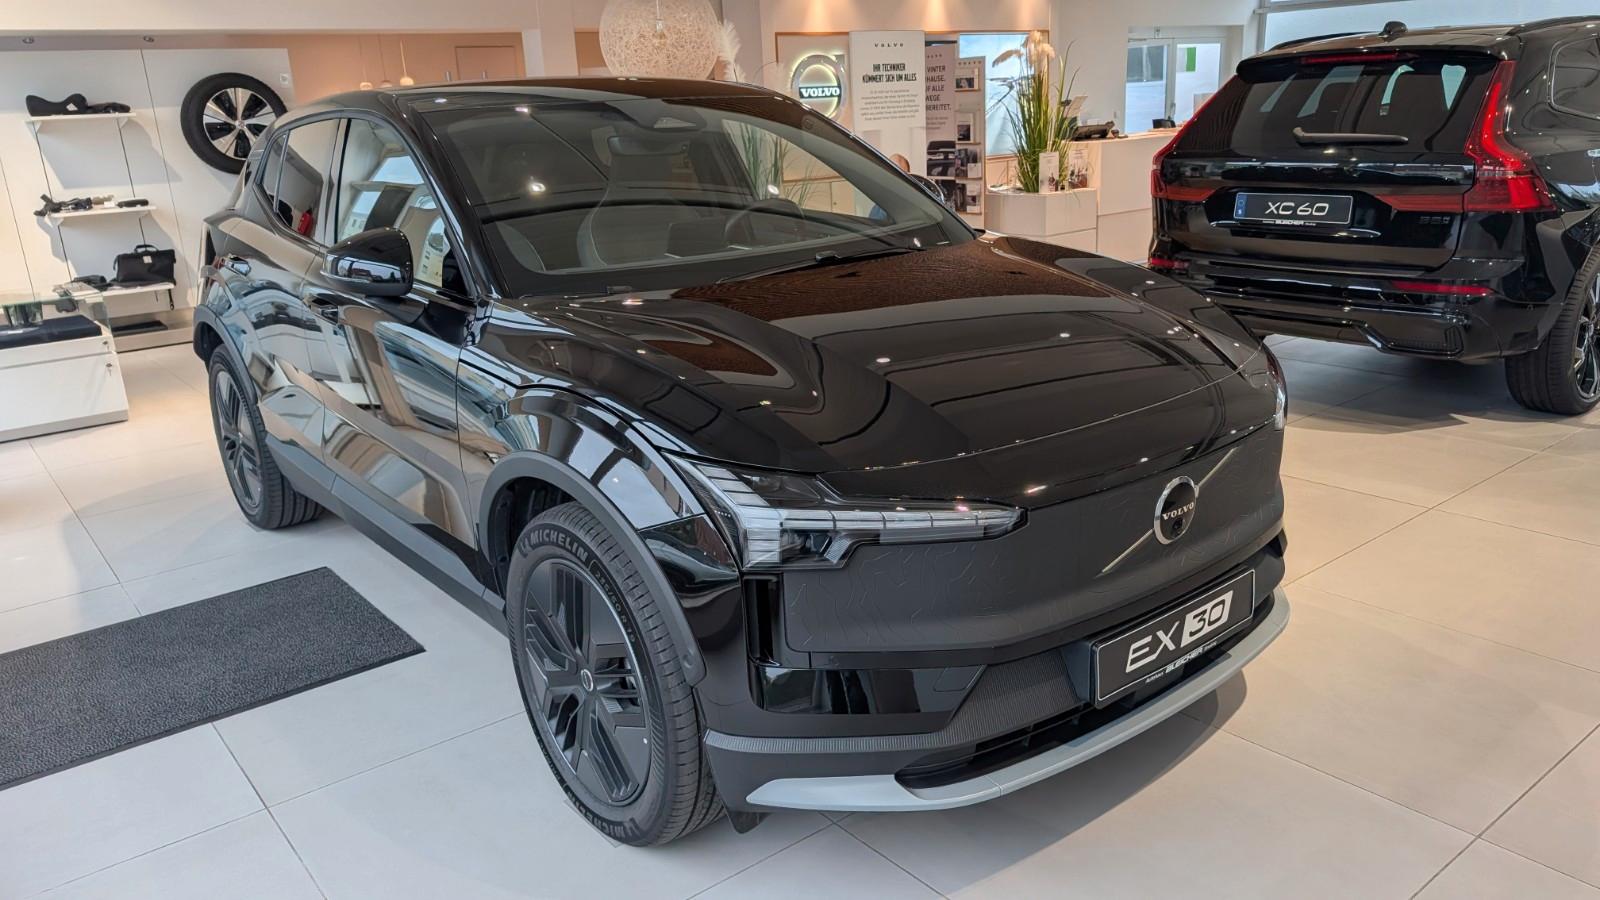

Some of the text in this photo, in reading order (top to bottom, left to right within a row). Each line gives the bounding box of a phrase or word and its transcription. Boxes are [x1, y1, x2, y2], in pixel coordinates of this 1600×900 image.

[872, 63, 906, 72] IHR TECHNIKER
[885, 73, 895, 82] SICH
[895, 73, 903, 82] UM
[904, 72, 917, 82] ALLES
[800, 86, 840, 97] VOLVO
[1162, 501, 1195, 521] VOLVO
[530, 529, 588, 562] MICHELIN
